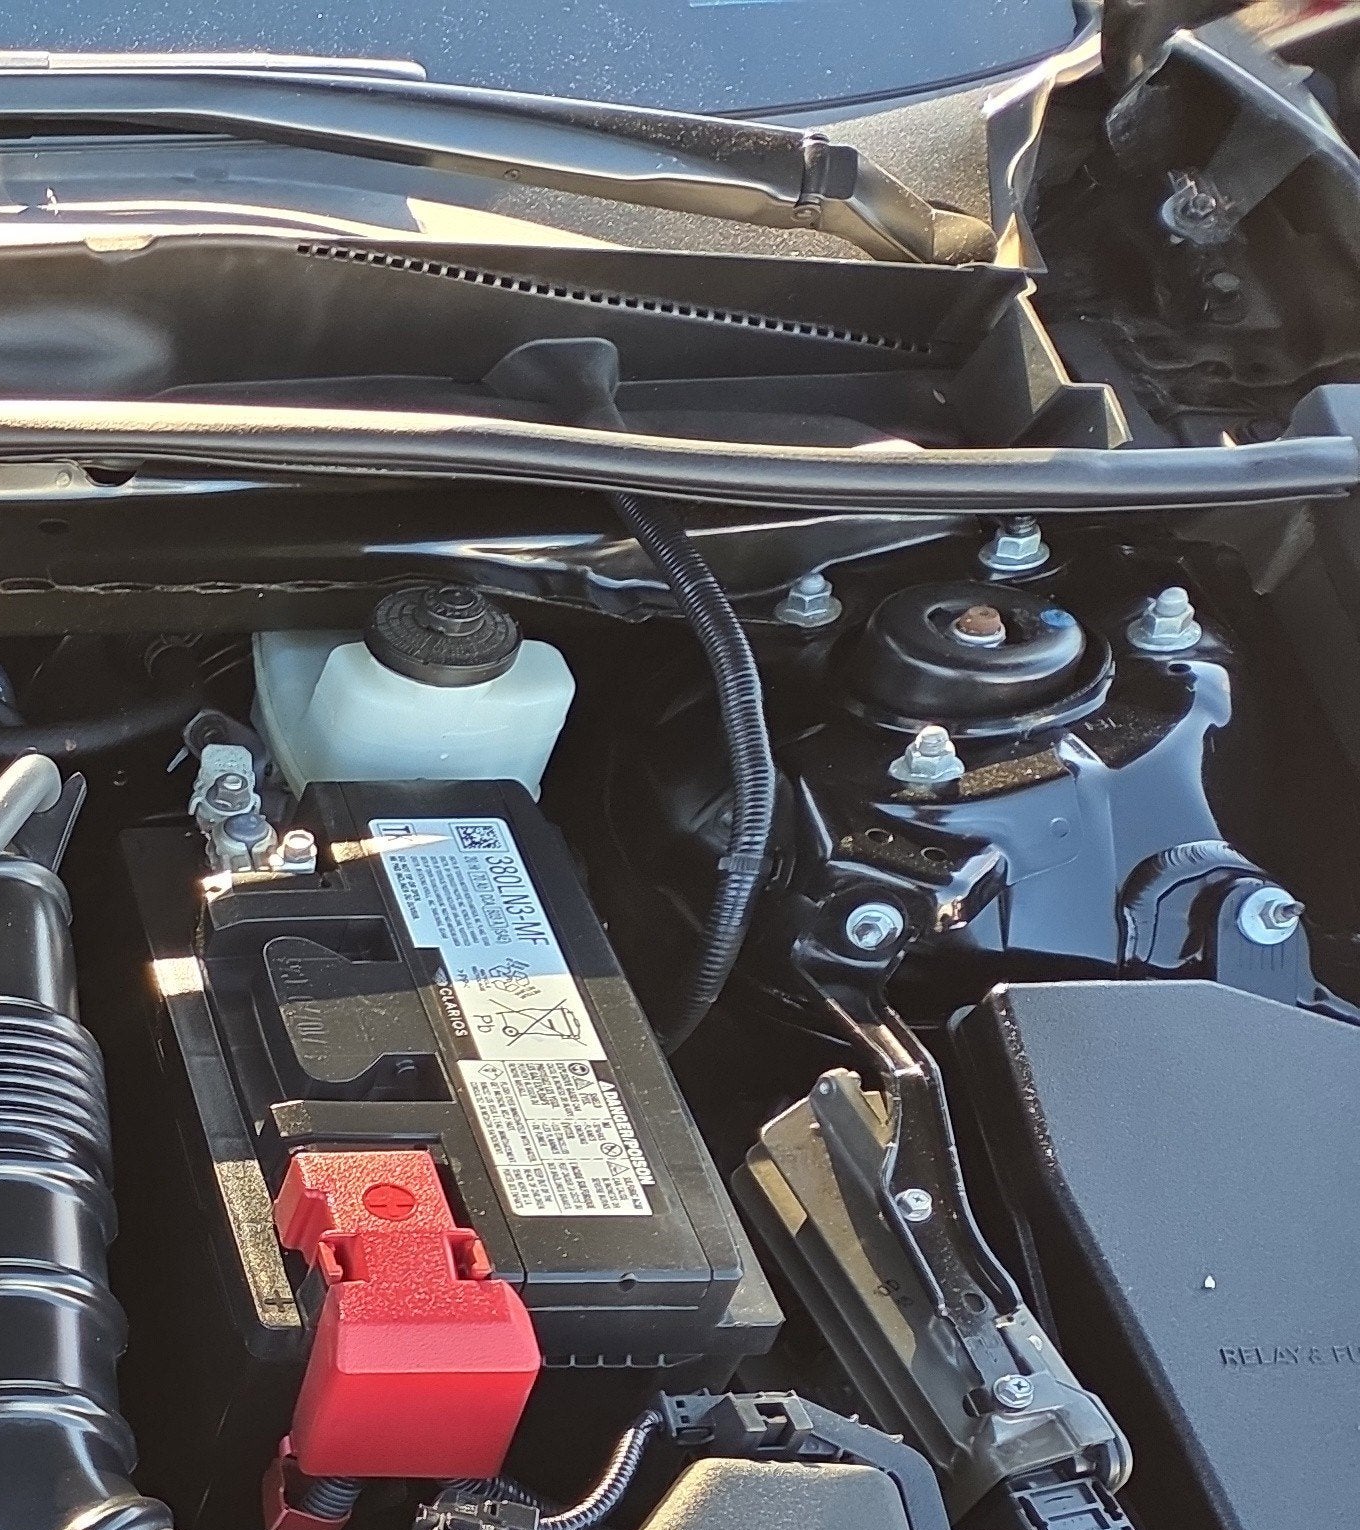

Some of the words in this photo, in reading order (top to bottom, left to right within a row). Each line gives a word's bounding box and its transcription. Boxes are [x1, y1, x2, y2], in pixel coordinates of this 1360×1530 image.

[485, 856, 550, 946] 380LN3-MF
[439, 987, 468, 1037] CLARIOS
[471, 1015, 499, 1032] Pb
[602, 1091, 655, 1184] DANGER/POISON
[1218, 1347, 1299, 1365] RELAY
